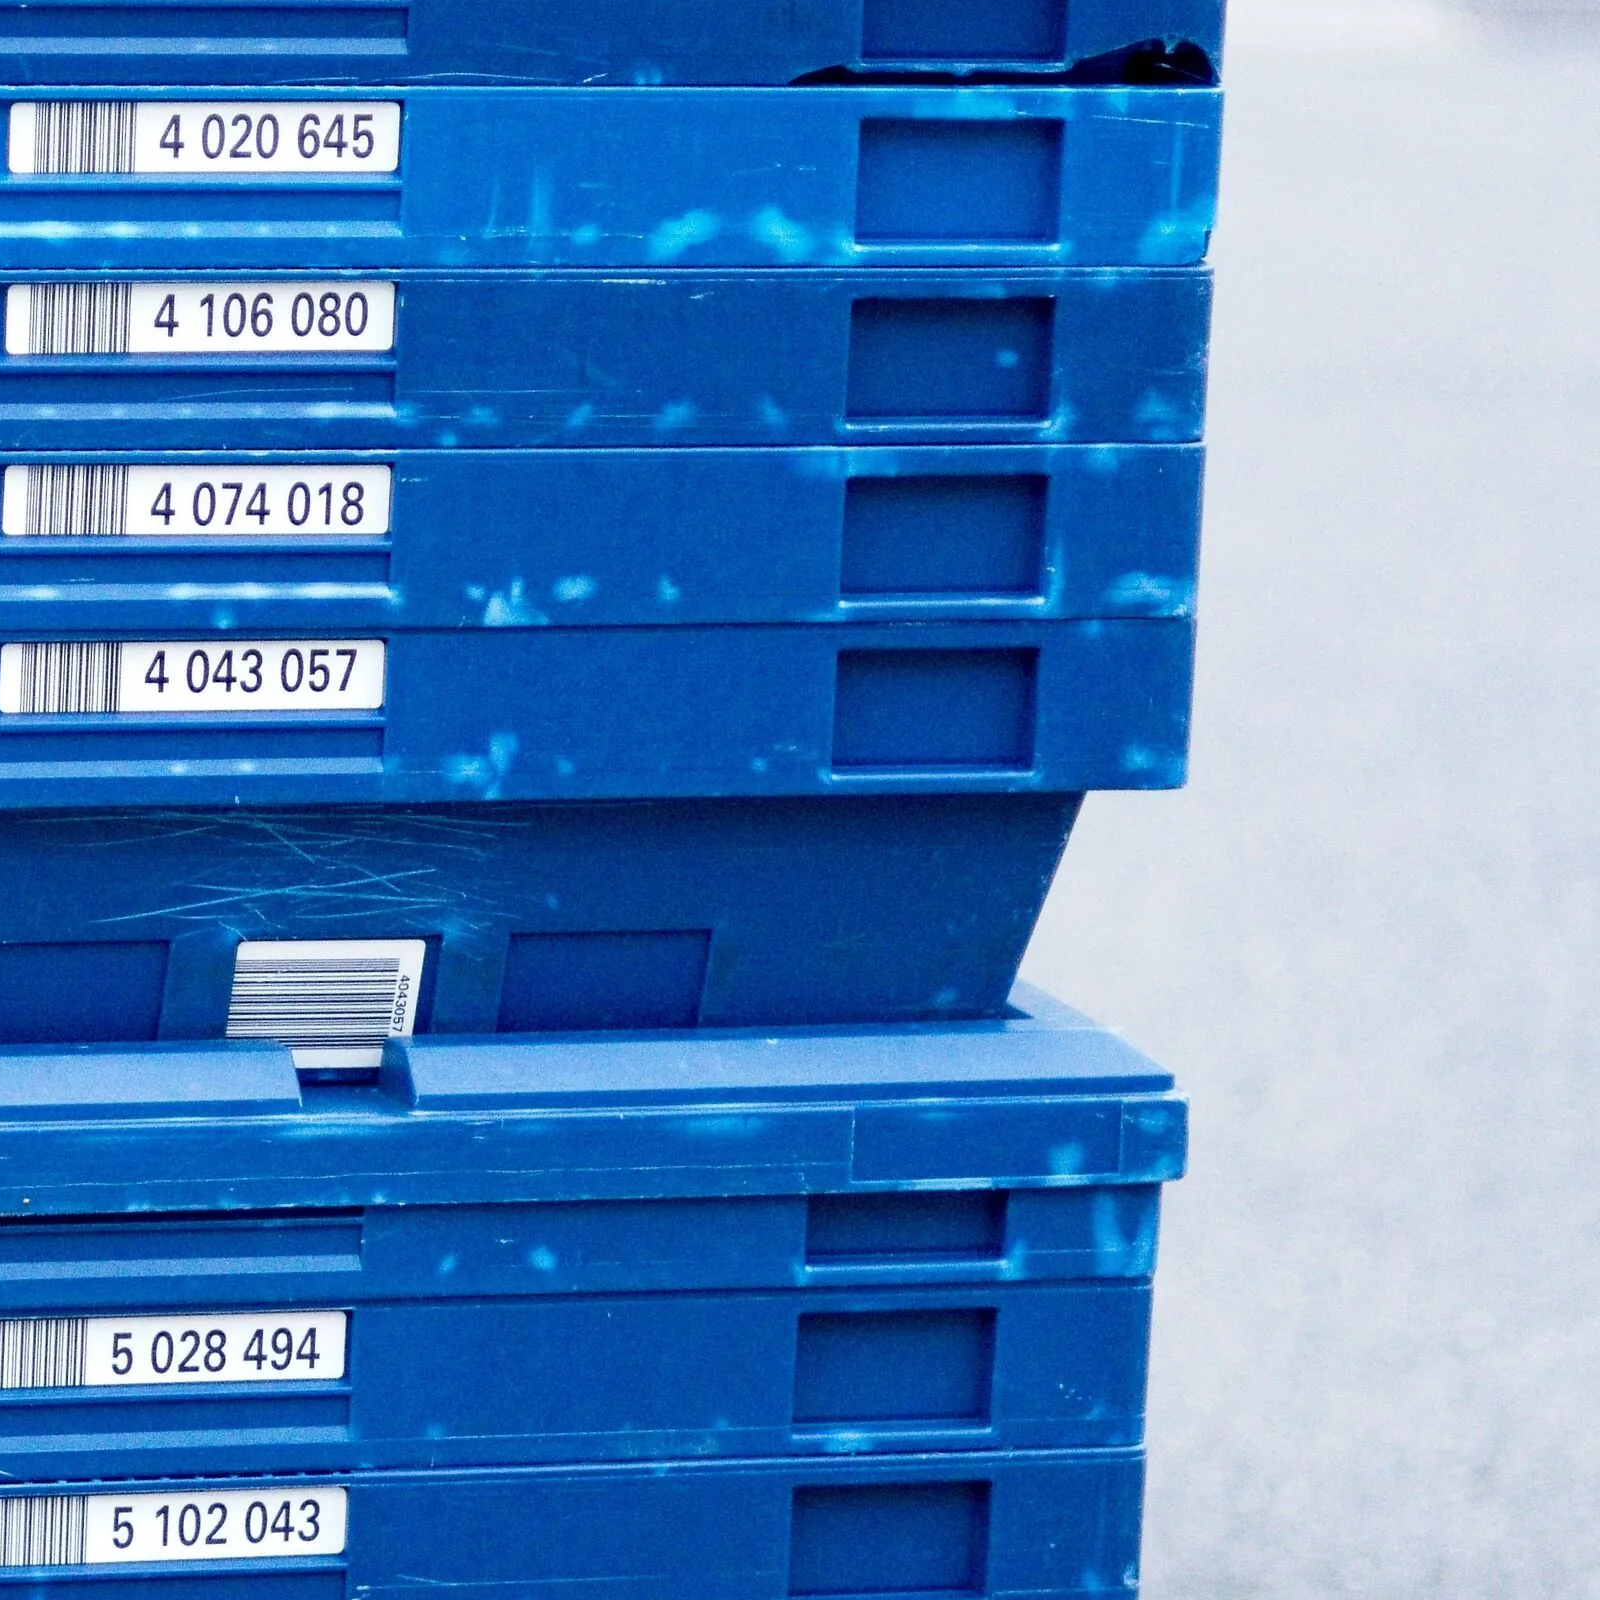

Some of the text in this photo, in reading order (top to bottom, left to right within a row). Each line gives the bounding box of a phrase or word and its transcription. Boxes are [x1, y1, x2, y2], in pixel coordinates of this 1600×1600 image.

[159, 113, 374, 160] 4 020 645
[154, 291, 369, 338] 4 106 080
[150, 481, 365, 527] 4 074 018
[144, 648, 358, 694] 4 043 057
[392, 974, 410, 1033] 4043057
[111, 1327, 320, 1375] 5 028 494
[112, 1498, 320, 1549] 5 102 043
